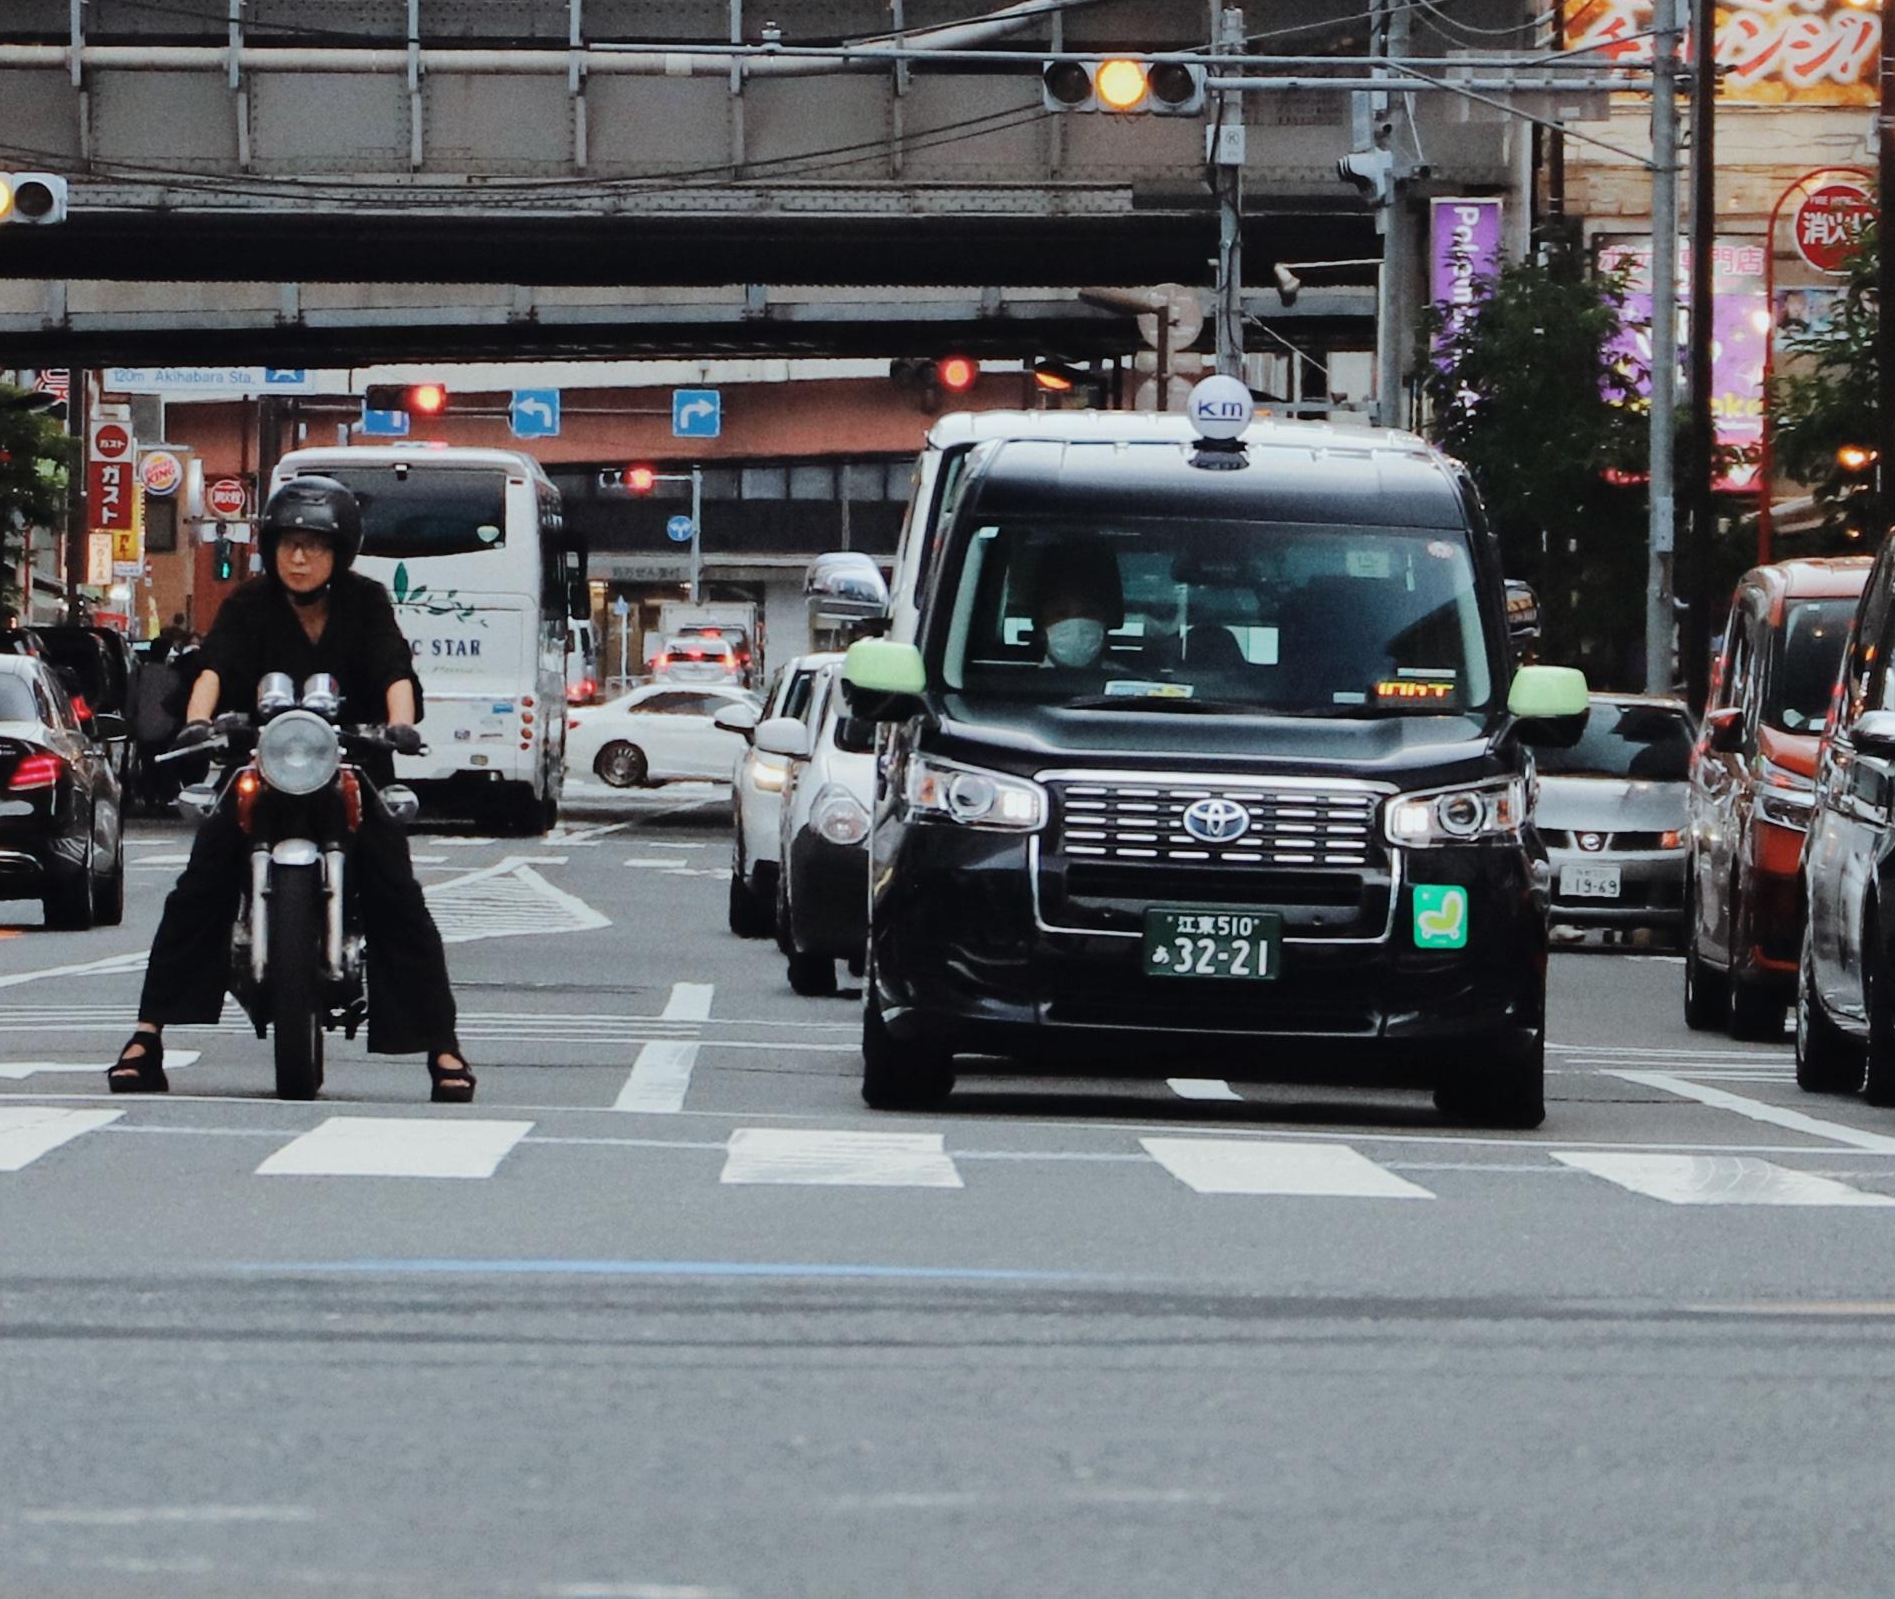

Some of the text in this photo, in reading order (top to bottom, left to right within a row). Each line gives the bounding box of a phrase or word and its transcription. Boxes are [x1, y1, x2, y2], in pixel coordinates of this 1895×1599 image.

[113, 369, 145, 383] 120m
[154, 369, 225, 384] Akihabara
[98, 439, 126, 449] ガスト
[145, 466, 177, 487] KING
[101, 464, 120, 525] ガスト
[431, 638, 482, 656] STAR
[1176, 915, 1253, 937] 江東510
[1151, 937, 1269, 976] あ 32-21
